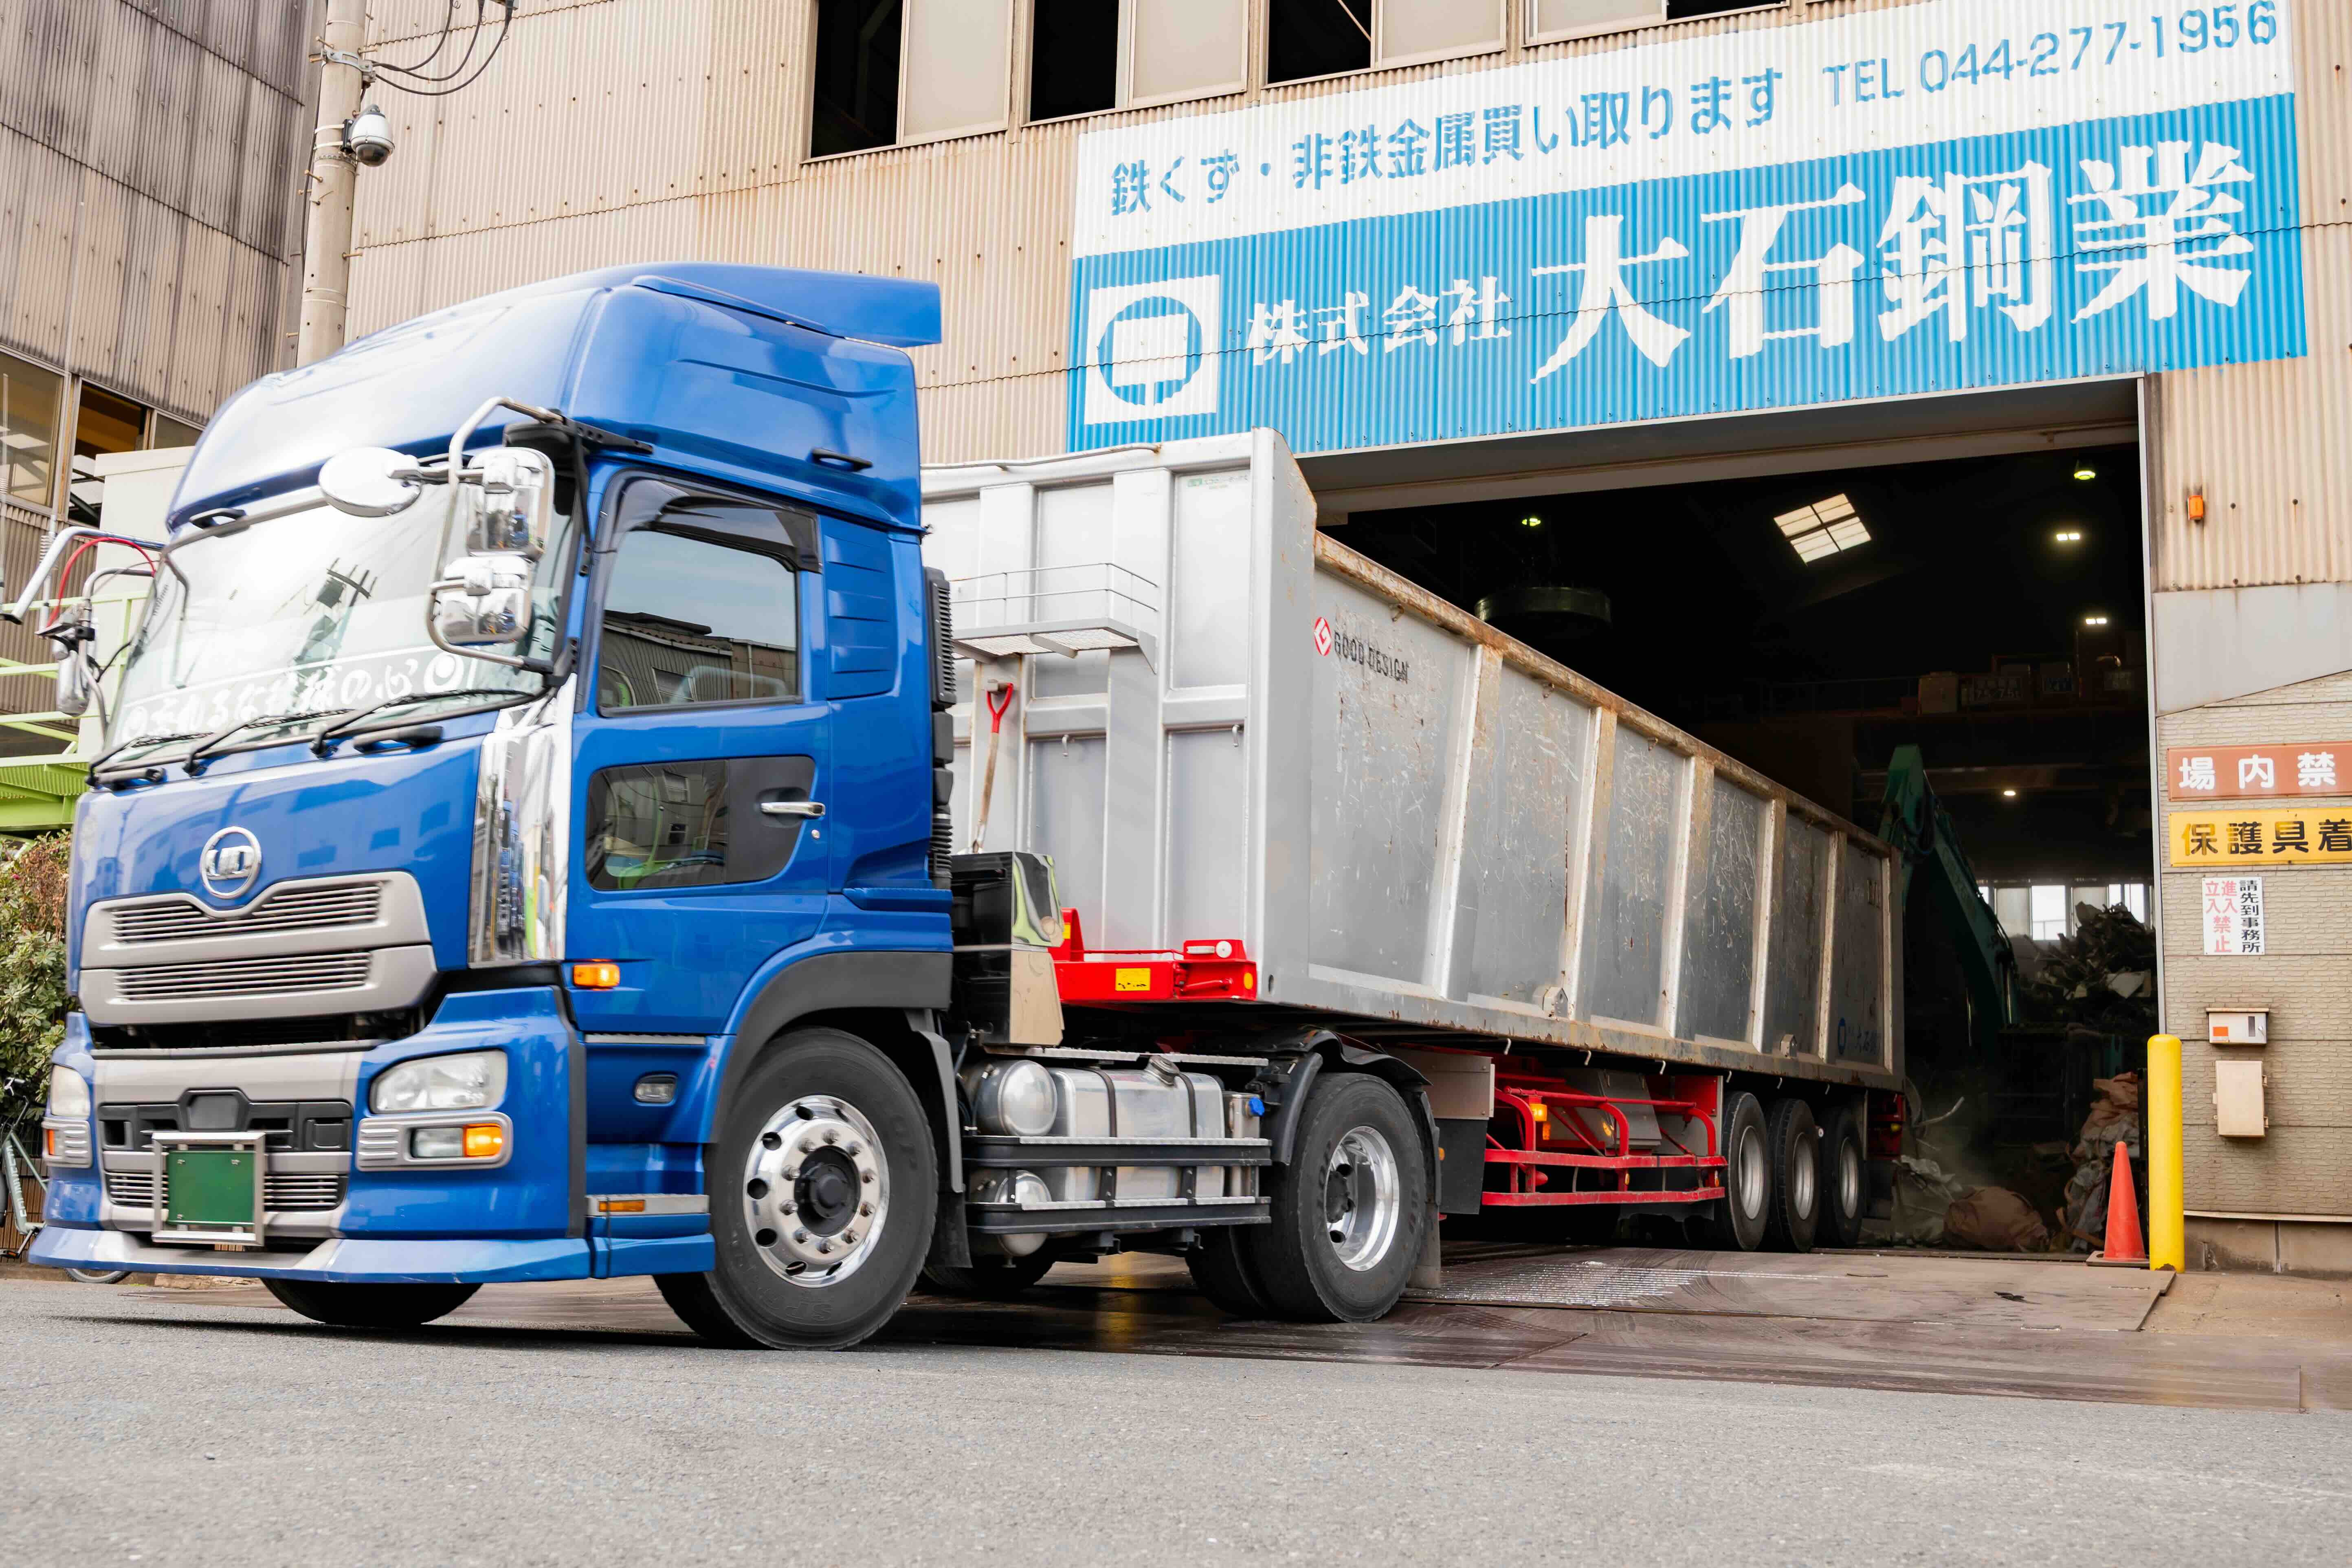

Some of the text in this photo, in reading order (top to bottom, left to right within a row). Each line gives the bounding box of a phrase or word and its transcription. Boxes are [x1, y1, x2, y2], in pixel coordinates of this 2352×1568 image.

[1112, 0, 2276, 215] 鉄くず・非鉄金属買い取ります TEL 044-277-1956
[1247, 141, 2255, 384] 株式会社 大石鋼業
[1334, 632, 1409, 684] GOOD DESIGN
[2239, 880, 2260, 952] 請先到事務所
